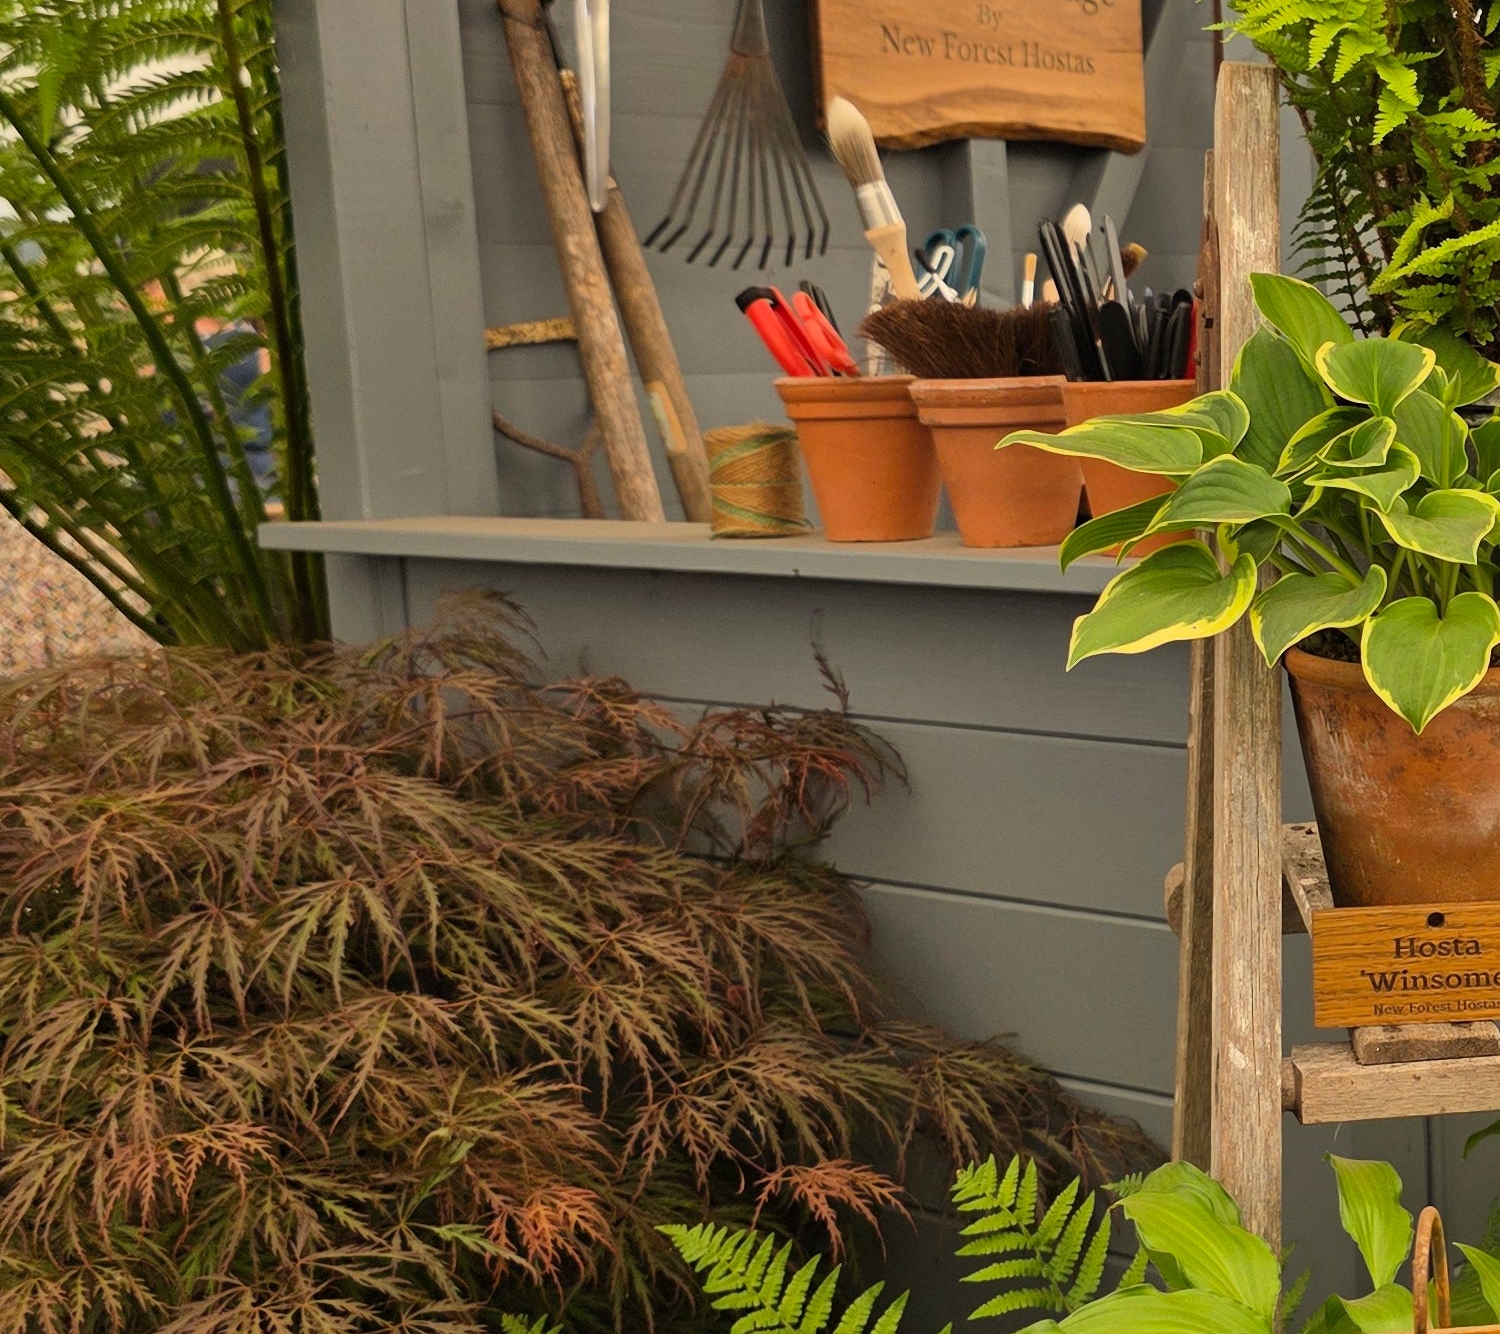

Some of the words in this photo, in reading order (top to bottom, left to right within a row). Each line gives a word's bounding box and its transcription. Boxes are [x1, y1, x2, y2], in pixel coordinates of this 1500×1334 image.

[978, 3, 1003, 31] By
[880, 24, 935, 57] New
[943, 31, 1014, 67] Forest
[1022, 41, 1096, 76] Hostas
[1393, 937, 1482, 959] Hosta
[1373, 1003, 1404, 1015] New
[1409, 1001, 1452, 1013] Forest
